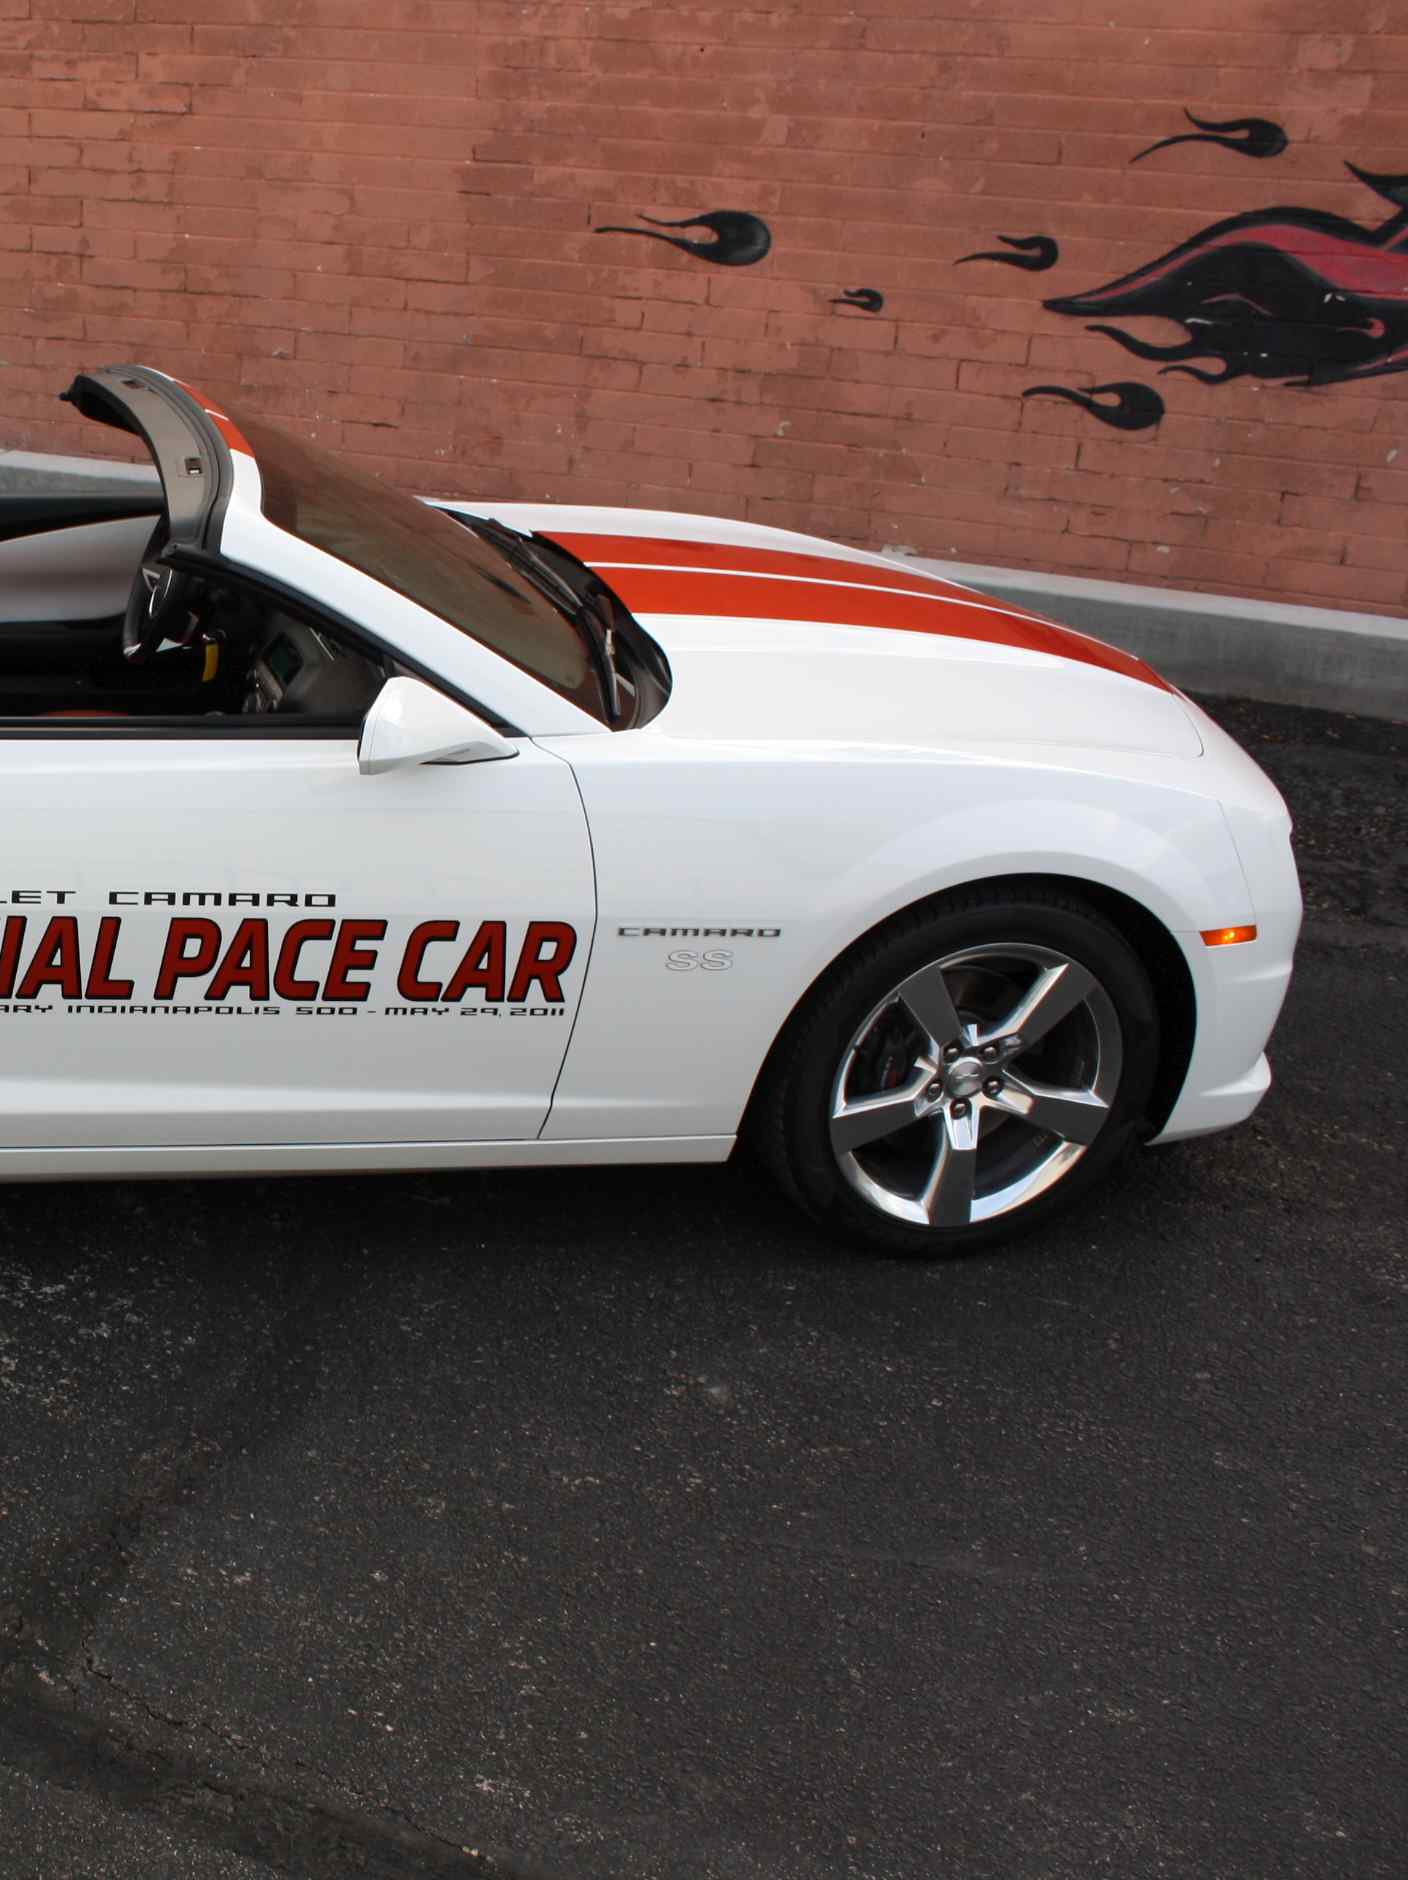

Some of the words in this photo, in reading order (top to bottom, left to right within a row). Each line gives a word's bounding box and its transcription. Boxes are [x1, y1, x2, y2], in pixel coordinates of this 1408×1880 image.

[108, 891, 337, 908] CAMARO
[617, 927, 782, 938] CAMARO
[153, 916, 389, 1001] PACE
[396, 919, 578, 1003] CAR
[665, 949, 734, 971] SS
[67, 1004, 281, 1016] INDIANAPOLIS
[295, 1006, 358, 1016] 500
[384, 1007, 451, 1017] MAY
[460, 1007, 503, 1018] 29,
[509, 1007, 565, 1017] 2011
